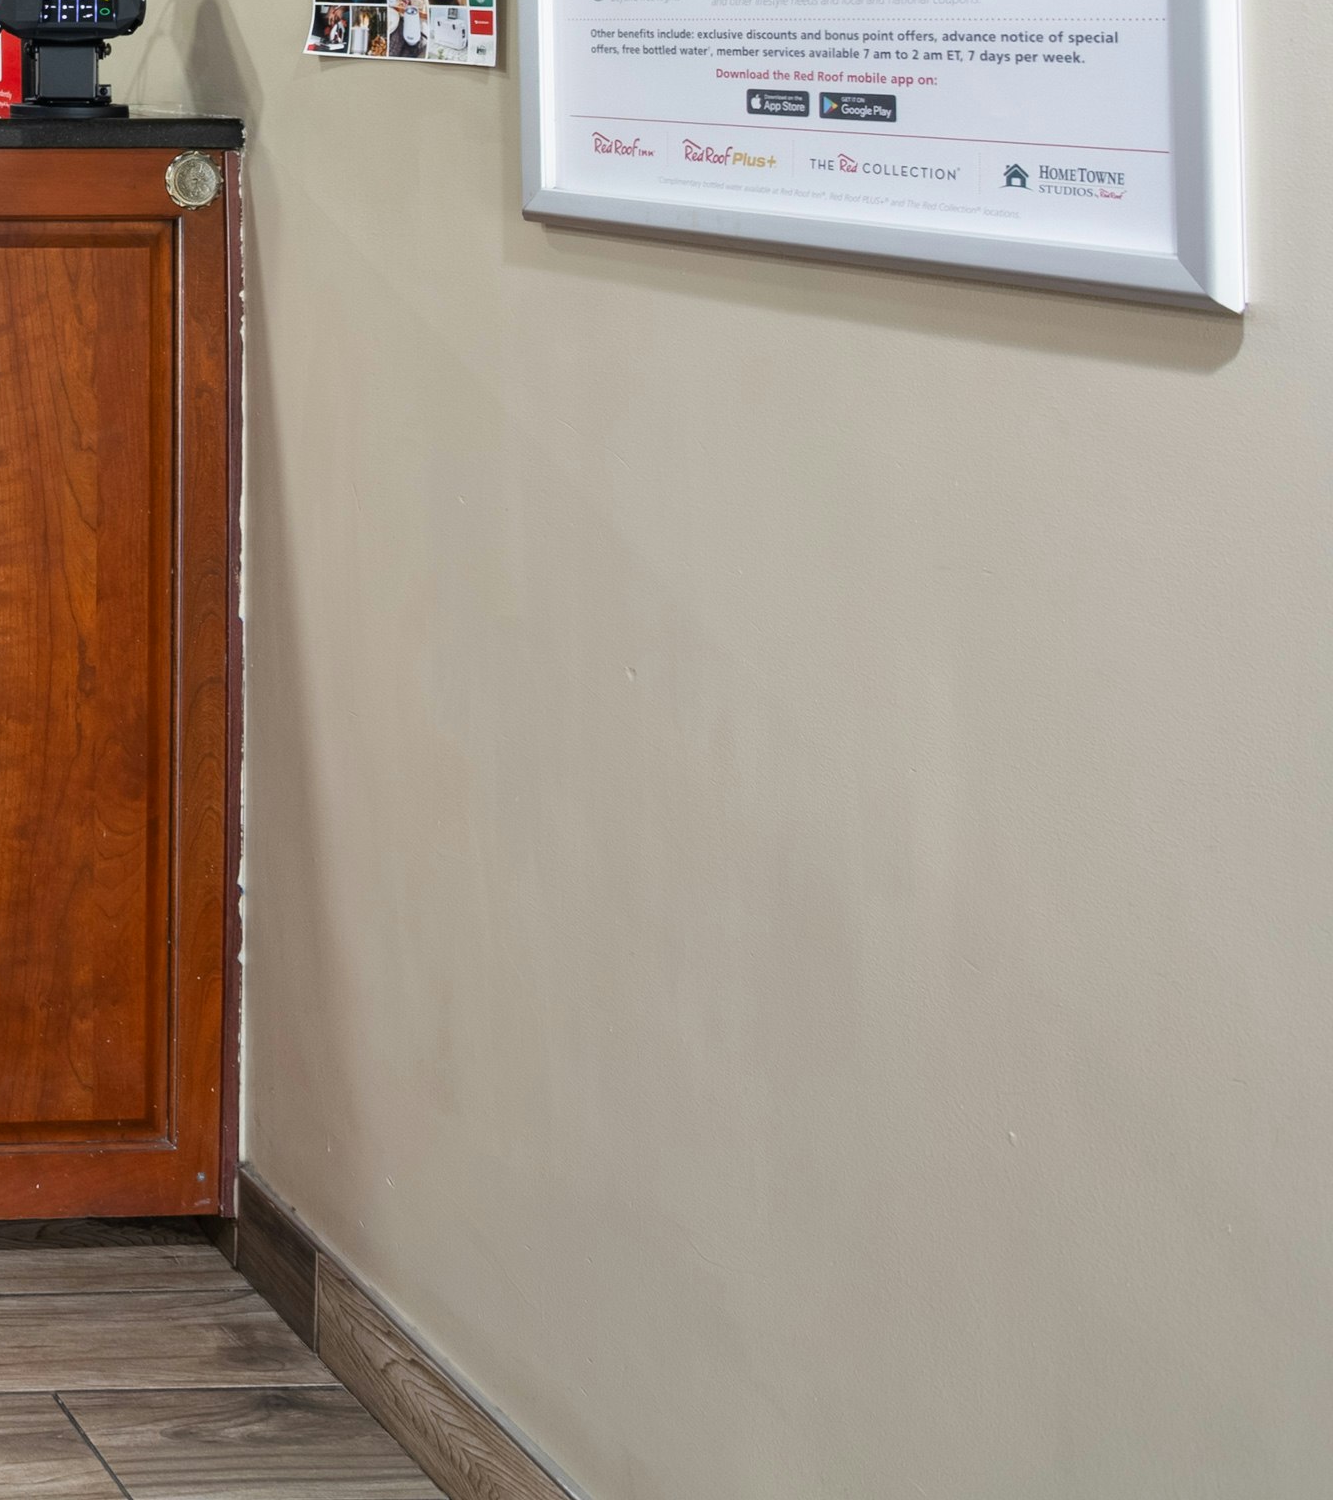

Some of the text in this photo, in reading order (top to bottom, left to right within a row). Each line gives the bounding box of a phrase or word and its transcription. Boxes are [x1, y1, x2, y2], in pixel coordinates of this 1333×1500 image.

[589, 28, 1119, 46] Other benefits include: exclusive discounts and bonus point offers, advance notice of special
[715, 67, 937, 87] Download the Red Roof mobile app on:
[763, 99, 806, 112] App Store
[840, 102, 892, 119] Google Play
[594, 138, 613, 154] Red
[614, 138, 640, 157] Roof
[685, 145, 777, 168] Red Roof Plus+
[810, 158, 957, 181] THE Red COLLECTION
[1039, 184, 1093, 198] STUDIOS
